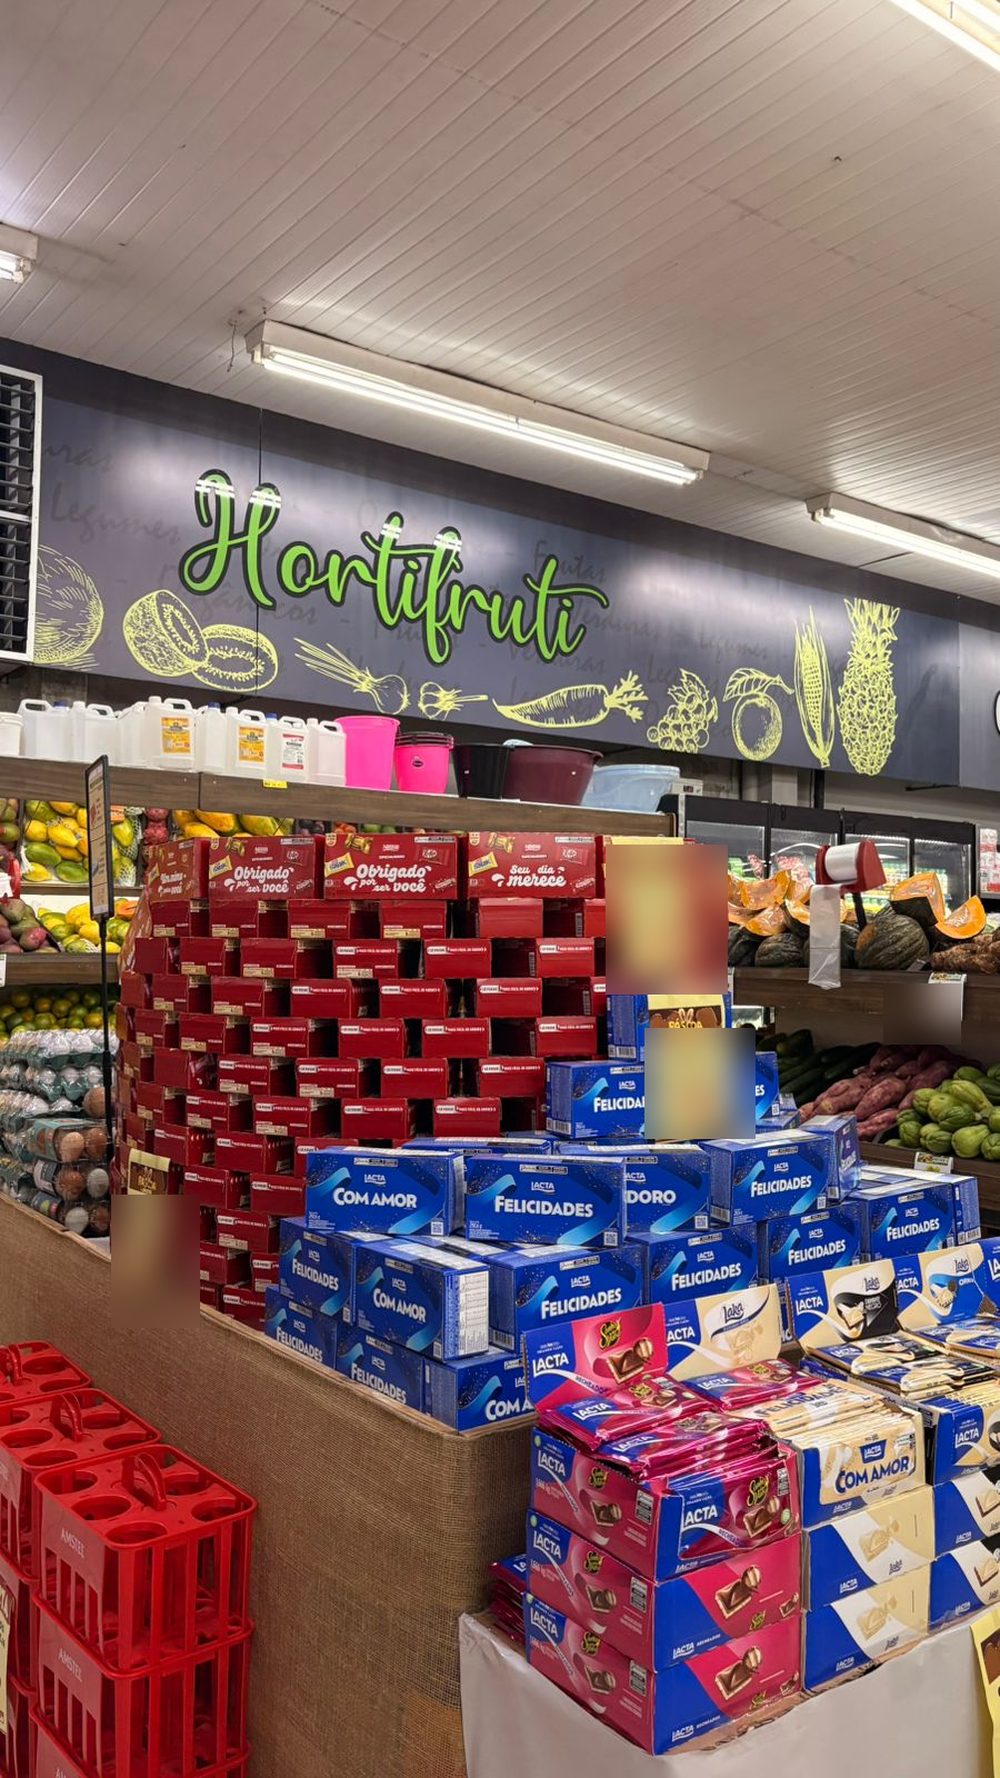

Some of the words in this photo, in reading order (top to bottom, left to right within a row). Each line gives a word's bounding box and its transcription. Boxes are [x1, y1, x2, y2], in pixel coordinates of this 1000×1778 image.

[179, 469, 609, 664] Hortifruti
[234, 866, 289, 883] Obrigado
[356, 864, 427, 882] Obrigado
[506, 873, 567, 887] merece
[510, 865, 530, 874] Seu
[537, 865, 555, 874] dia
[392, 878, 427, 892] você
[364, 1174, 387, 1185] LACTA
[531, 1181, 556, 1192] LACTA
[750, 1175, 812, 1197] FELICIDADES
[333, 1187, 369, 1206] COM
[371, 1192, 417, 1209] AMOR
[494, 1195, 594, 1218] FELICIDADES
[625, 1190, 677, 1204] DORO
[886, 1218, 940, 1242] FELICIDADES
[788, 1240, 846, 1265] FELICIDADES
[292, 1259, 339, 1291] FELICIDADES
[571, 1275, 591, 1287] LACTA
[671, 1263, 742, 1291] FELICIDADES
[373, 1288, 396, 1309] COM
[396, 1299, 427, 1324] AMOR
[540, 1288, 622, 1320] FELICIDADES
[723, 1302, 745, 1323] Laka
[795, 1296, 824, 1315] LACTA
[667, 1325, 696, 1342] ACTA
[276, 1327, 323, 1363] FELICIDADES
[532, 1352, 569, 1378] LACTA
[351, 1363, 407, 1405] FELICIDADES
[485, 1398, 520, 1421] COM
[572, 1402, 614, 1421] LACTA
[955, 1427, 980, 1448] LACTA
[538, 1450, 566, 1476] LACTA
[835, 1469, 869, 1494] COM
[870, 1456, 910, 1483] AMOR
[684, 1504, 719, 1526] ACTA
[60, 1527, 86, 1559] AMSTEL
[533, 1531, 561, 1559] LACTA
[530, 1607, 559, 1637] LACTA
[673, 1642, 695, 1659] LACTA
[57, 1648, 83, 1682] AMSTEL
[671, 1724, 694, 1742] LACTA
